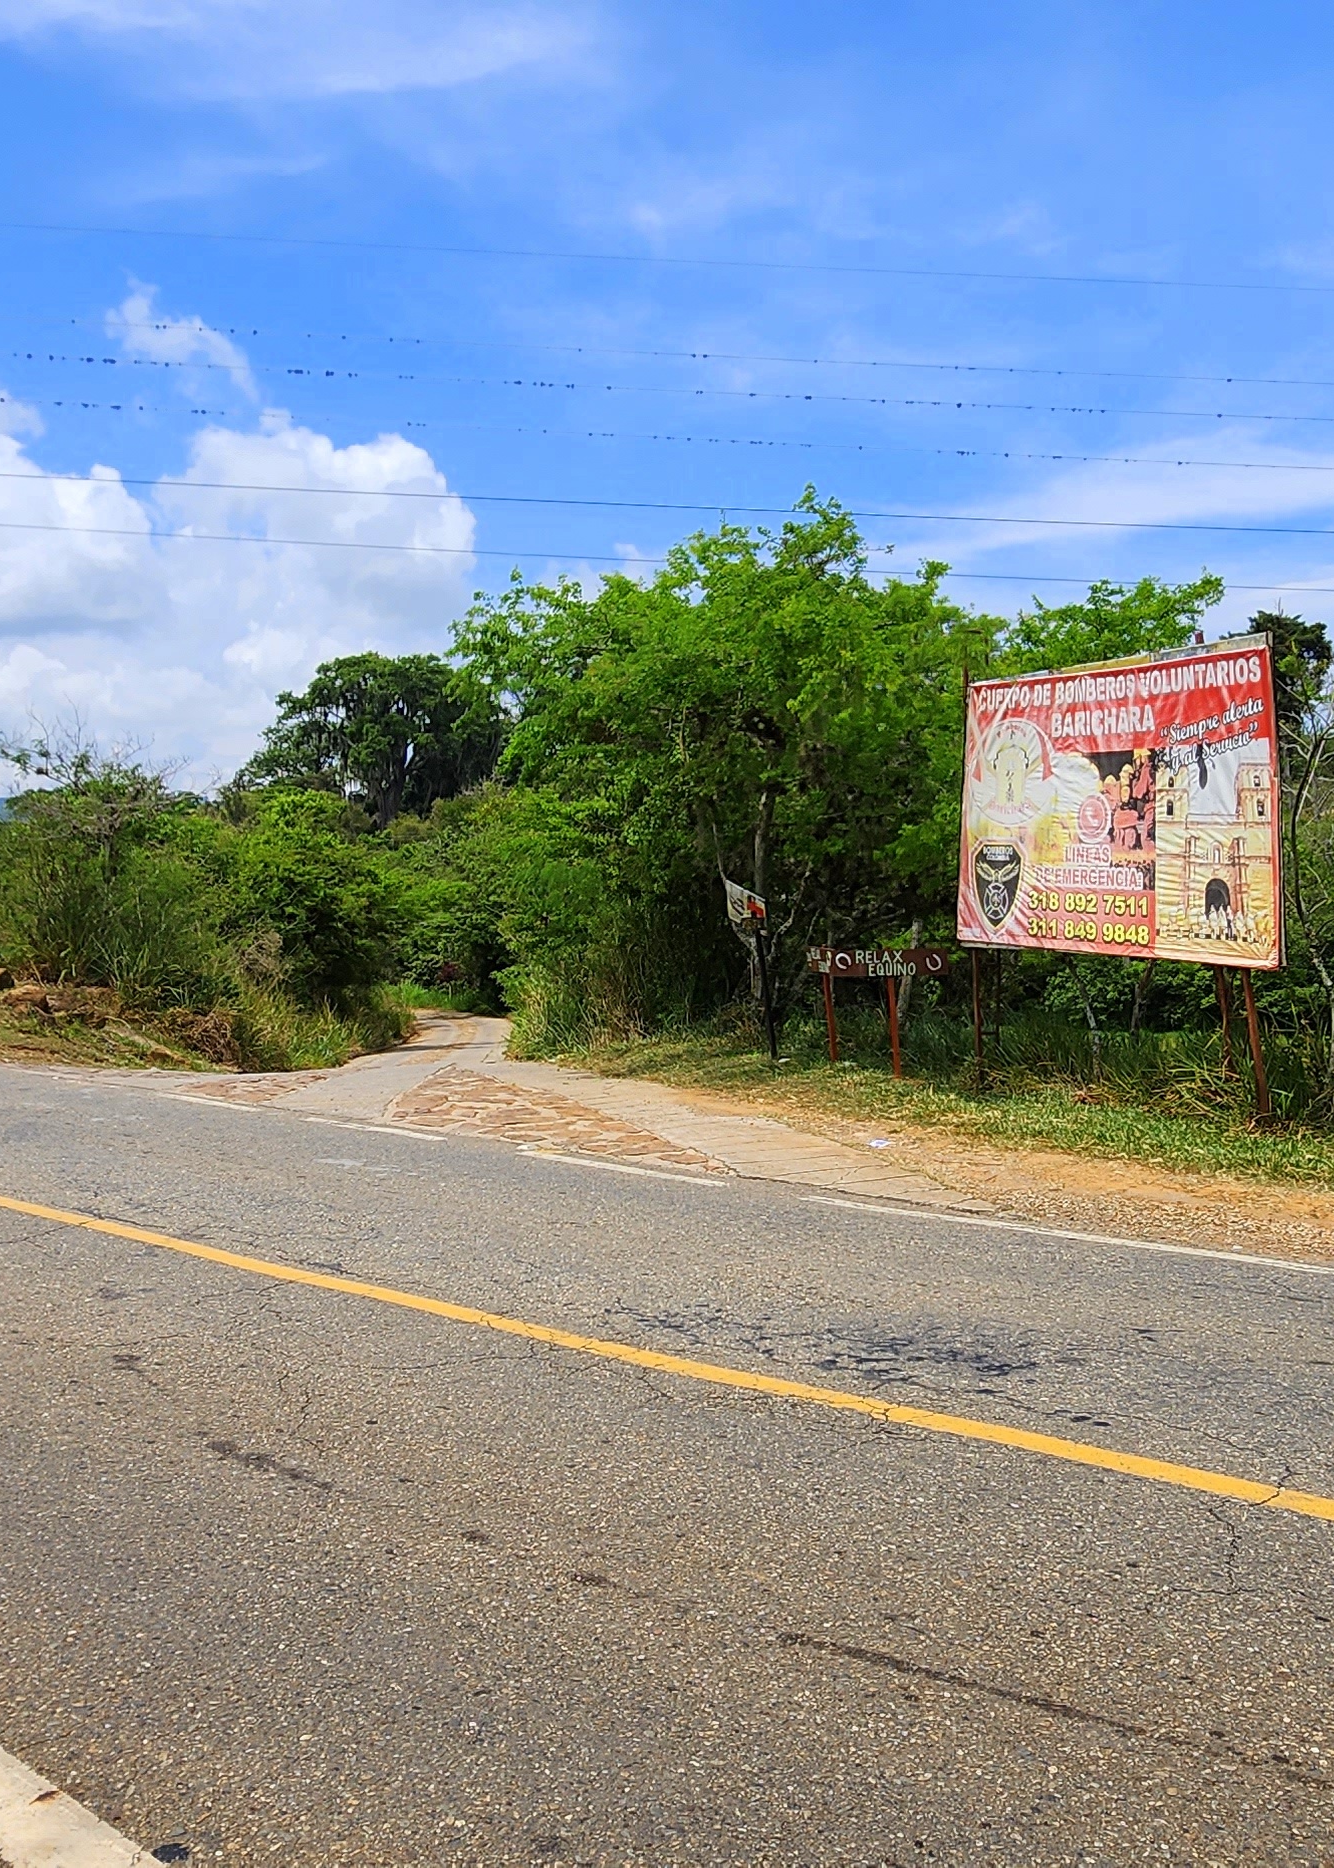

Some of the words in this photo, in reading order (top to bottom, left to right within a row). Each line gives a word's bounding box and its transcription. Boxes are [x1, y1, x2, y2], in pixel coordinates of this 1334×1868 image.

[1033, 683, 1052, 706] DE
[1055, 674, 1136, 705] BOMBEROS
[1139, 656, 1262, 699] VOLUNTARIOS
[1051, 704, 1155, 738] BARICHARA
[1222, 697, 1264, 725] alerta
[1183, 743, 1199, 766] al
[1028, 890, 1060, 911] 318
[1064, 892, 1098, 914] 892
[1102, 894, 1149, 917] 7511
[1028, 917, 1058, 938] 311
[1064, 919, 1098, 941] 849
[1102, 923, 1150, 945] 9848
[855, 950, 904, 964] RELAX
[868, 962, 917, 977] EQUINO
